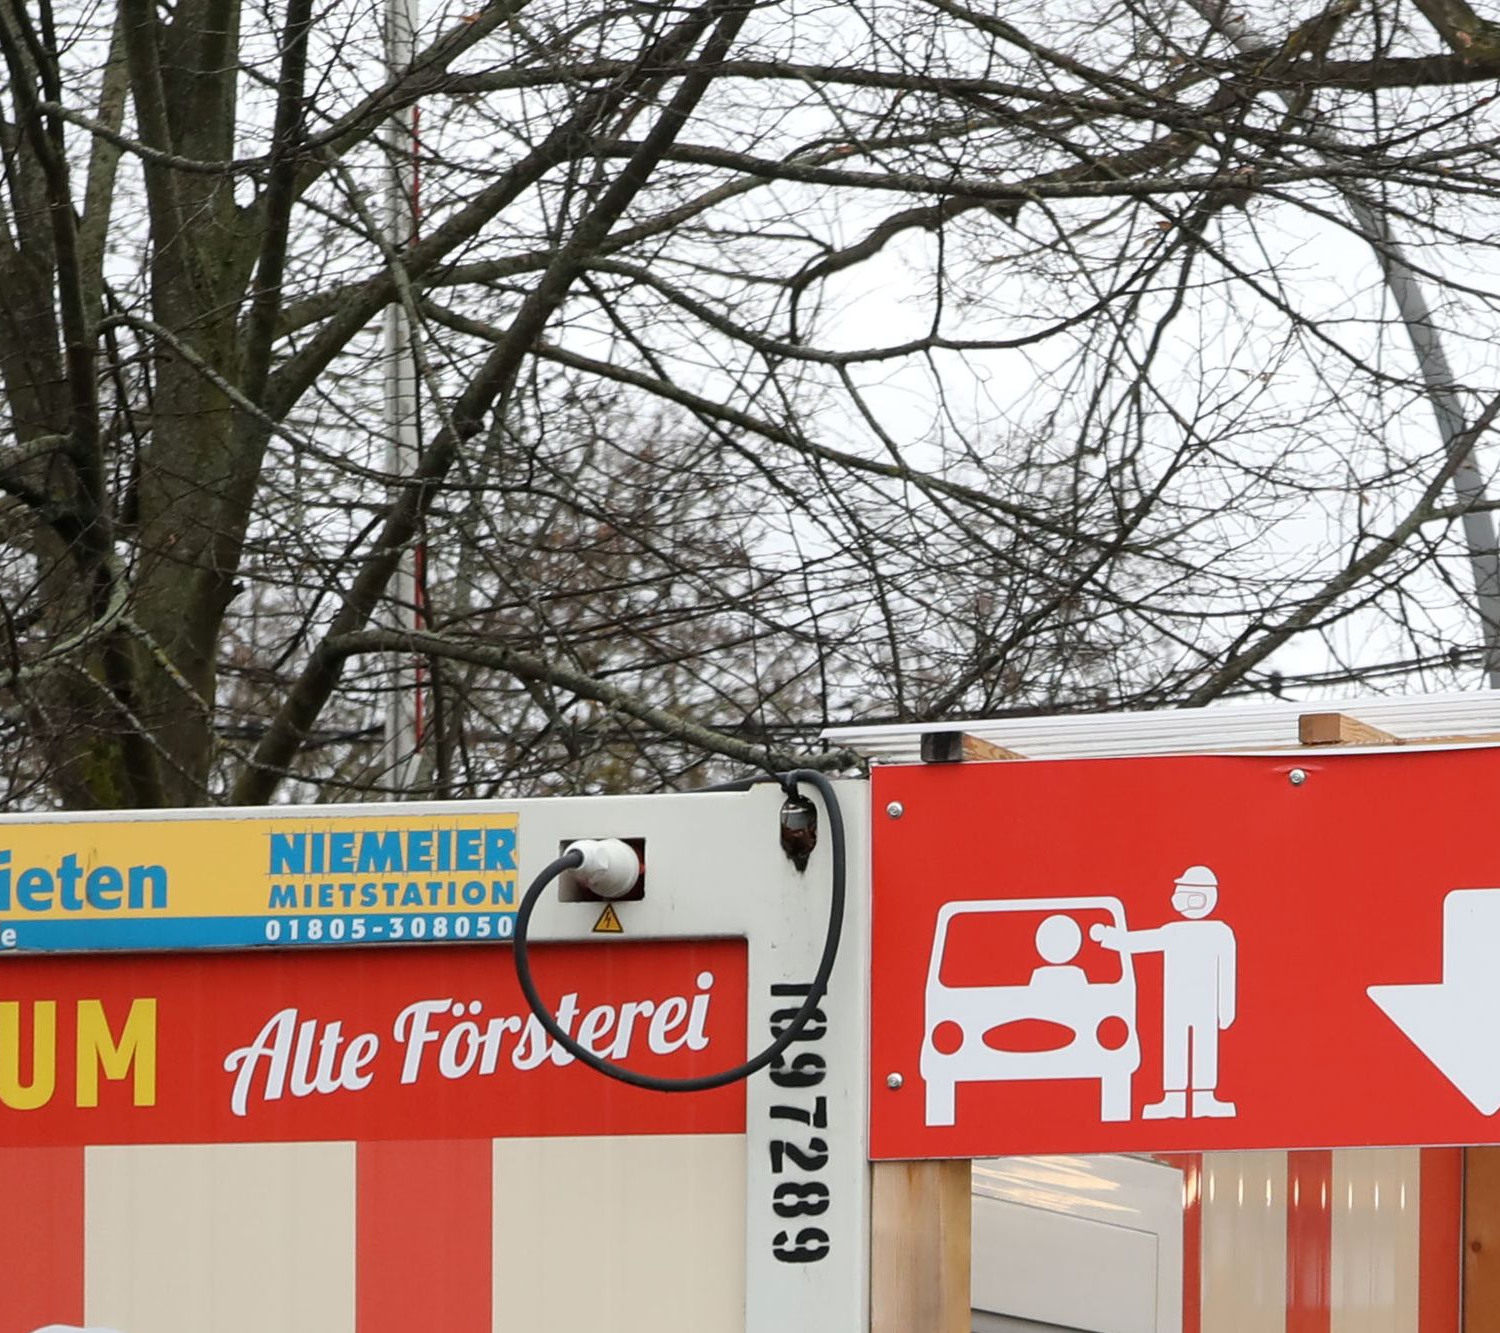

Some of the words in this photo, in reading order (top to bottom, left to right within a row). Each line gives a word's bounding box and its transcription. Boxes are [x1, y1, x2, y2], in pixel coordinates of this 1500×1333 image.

[269, 828, 518, 875] NIEMEIER
[268, 880, 514, 909] MIETSTATION
[265, 916, 513, 941] 01805-308050
[223, 1007, 380, 1117] Alte
[393, 971, 715, 1085] Försterei
[769, 981, 831, 1264] 1097289
